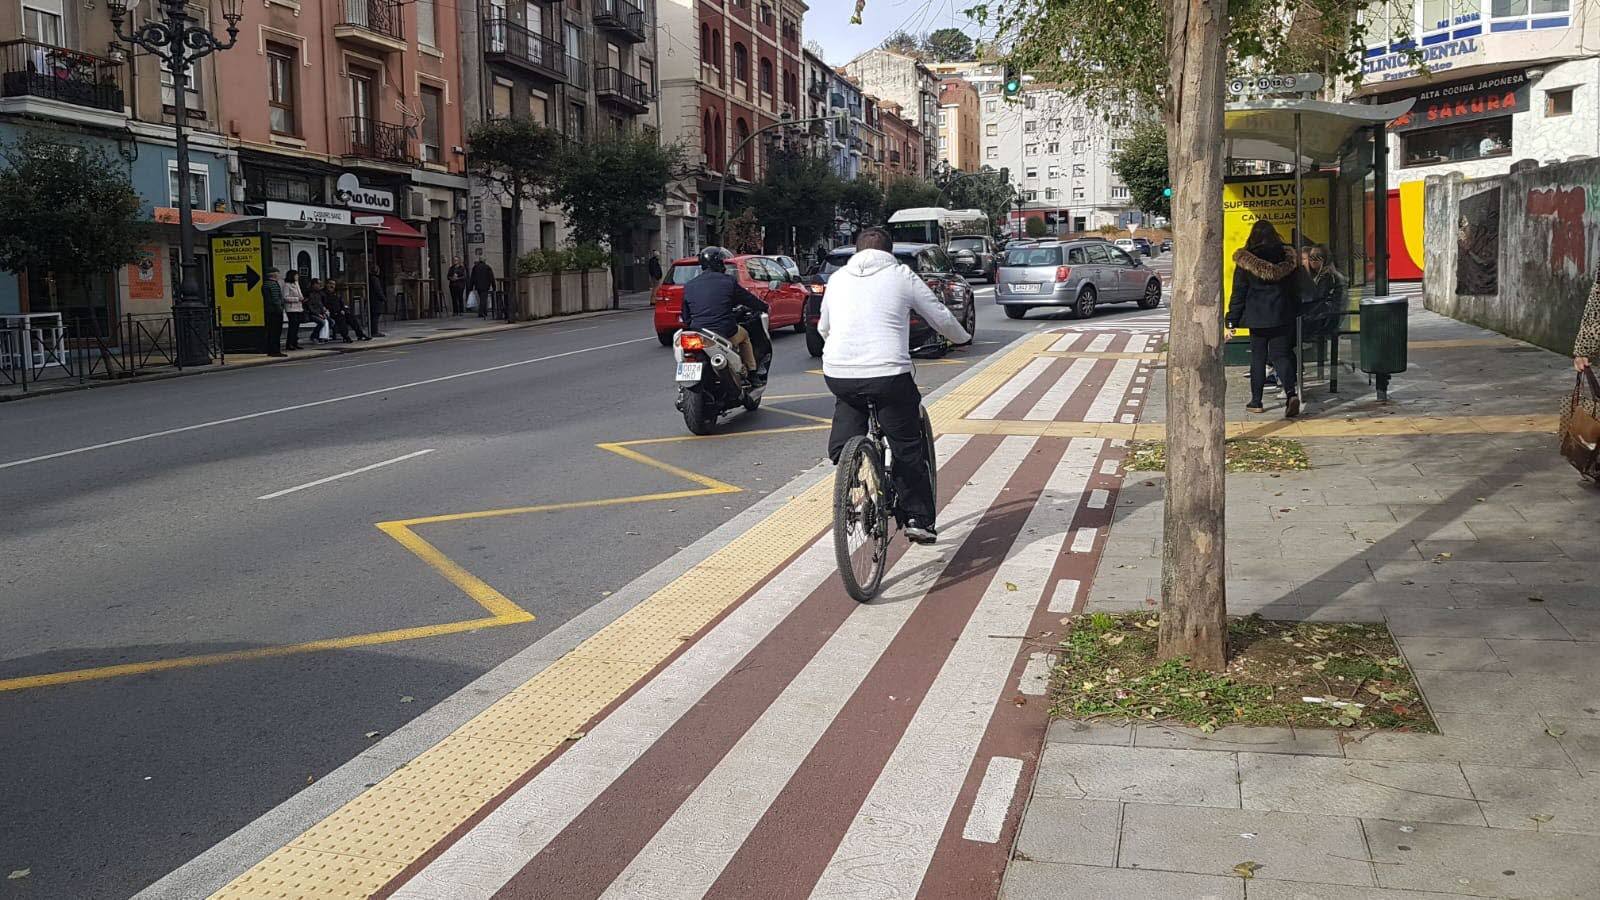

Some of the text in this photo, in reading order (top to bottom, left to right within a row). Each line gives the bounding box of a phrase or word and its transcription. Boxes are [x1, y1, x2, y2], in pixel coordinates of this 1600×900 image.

[1421, 38, 1477, 62] DENTAL
[1420, 74, 1524, 100] ALTA COCINA JAPONESA
[1427, 91, 1516, 121] SAKURA
[1243, 184, 1304, 198] NUEVO
[363, 192, 390, 208] tolva
[1224, 197, 1324, 209] SUPERMERCADO BM
[222, 239, 251, 248] NUEVO
